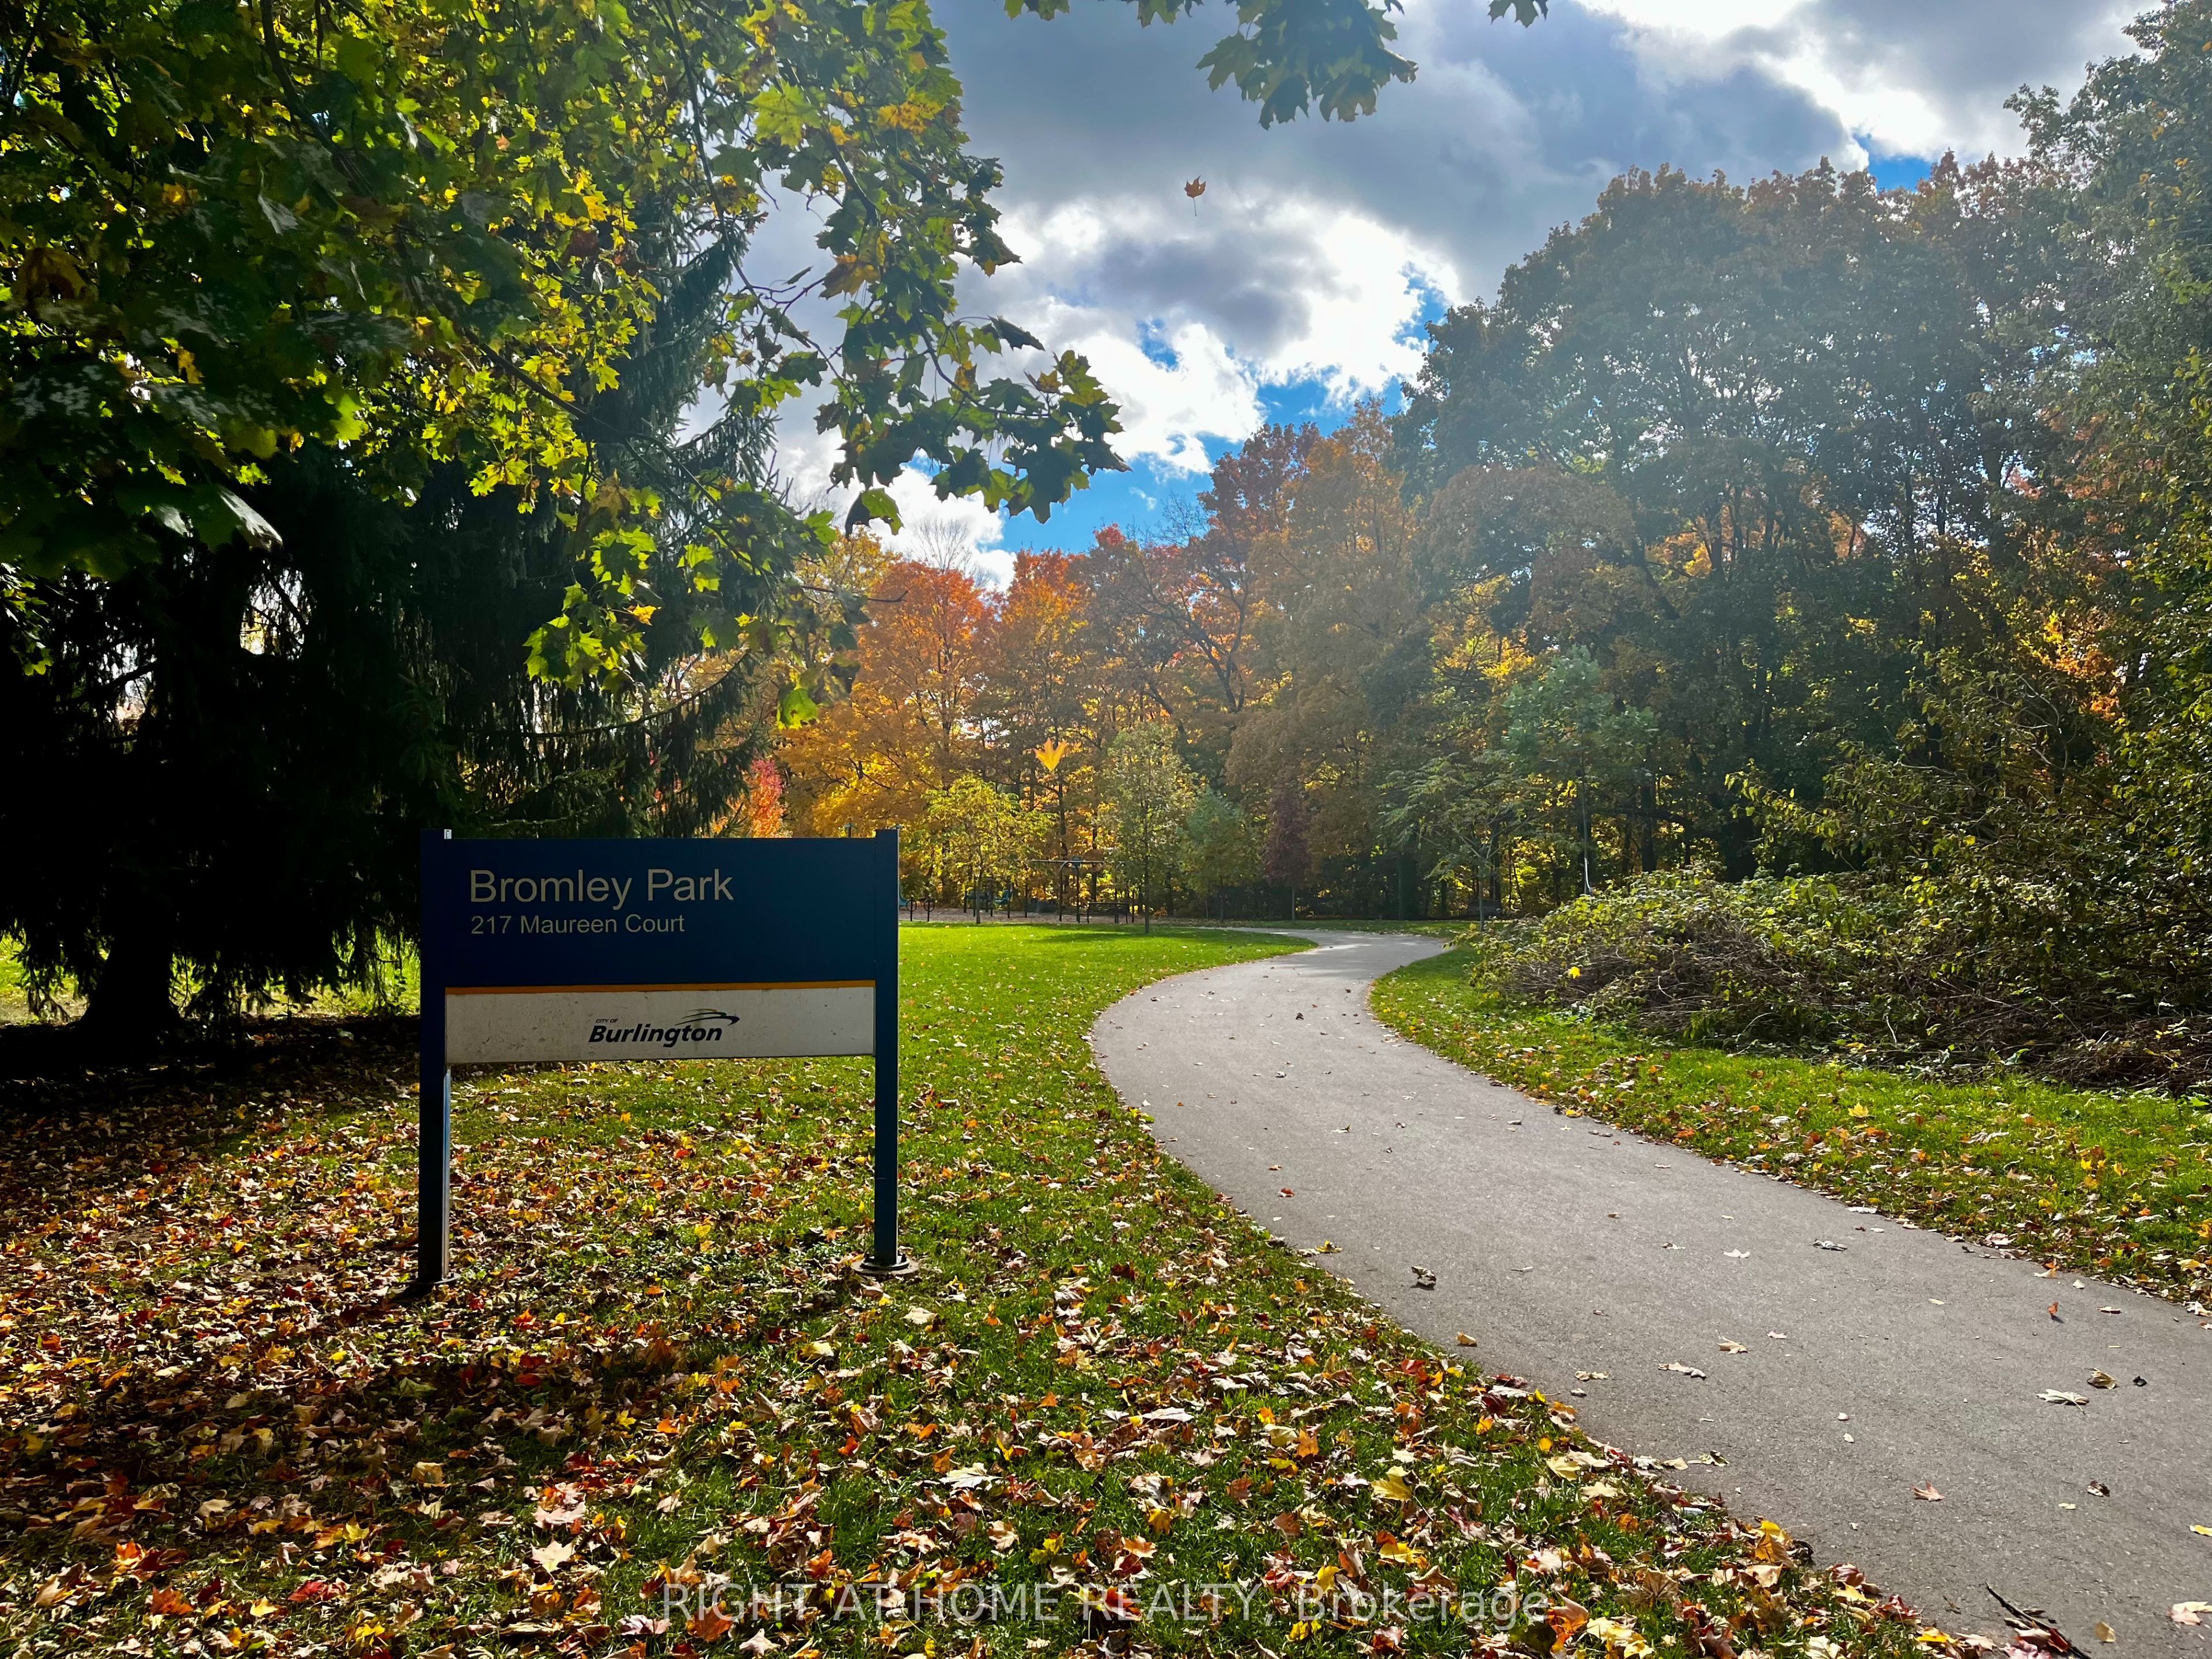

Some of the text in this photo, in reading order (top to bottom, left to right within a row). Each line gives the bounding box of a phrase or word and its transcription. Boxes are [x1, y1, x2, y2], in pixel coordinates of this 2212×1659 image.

[471, 868, 734, 910] Bromley Park
[471, 914, 685, 934] 217 Maureen Court
[589, 1024, 722, 1048] Burlington
